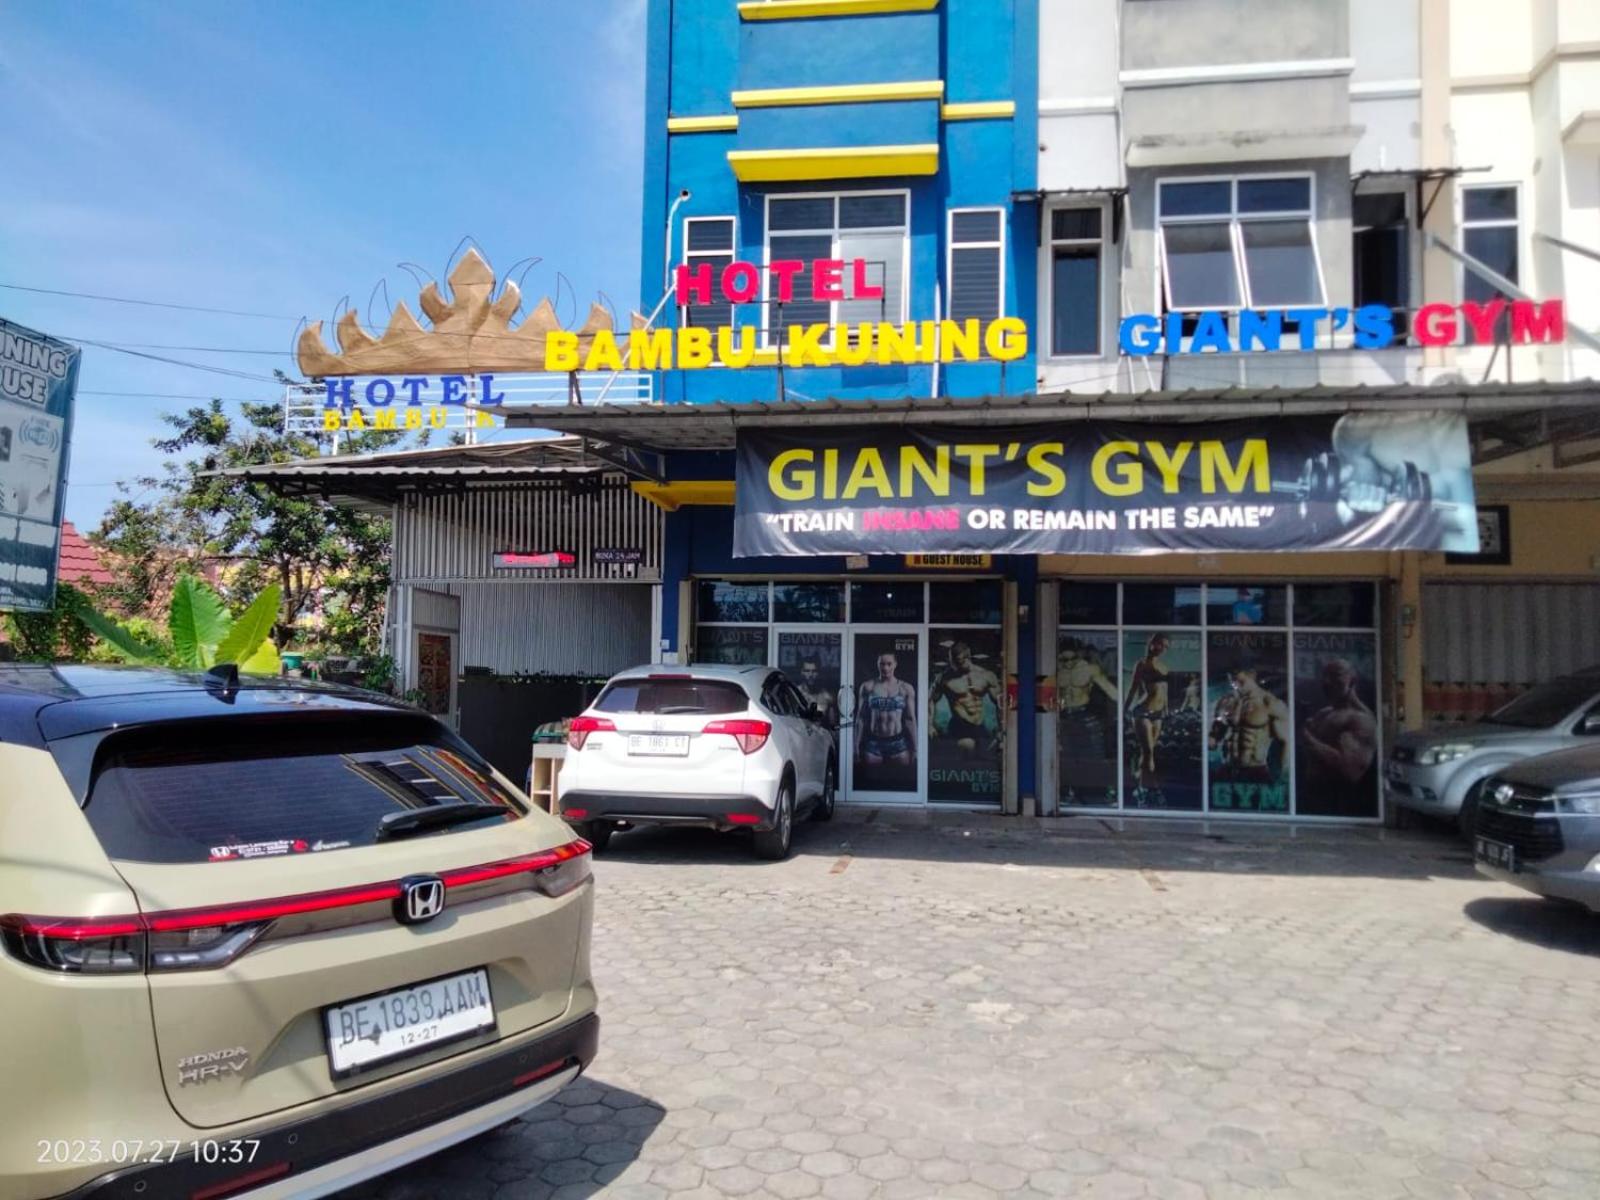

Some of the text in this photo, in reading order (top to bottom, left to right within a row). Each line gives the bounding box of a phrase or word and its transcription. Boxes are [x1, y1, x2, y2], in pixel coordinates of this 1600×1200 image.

[674, 258, 884, 305] HOTEL
[1119, 298, 1566, 357] GIANT'S GYM
[545, 317, 1028, 371] BAMBU KUNING
[324, 375, 505, 408] HOTEL
[322, 407, 448, 431] BAMBU
[768, 440, 1271, 501] GIANT'S GYM
[862, 508, 961, 531] INSANE
[967, 508, 1006, 529] OR
[1013, 509, 1117, 530] REMAIN
[1124, 508, 1176, 529] THE
[922, 554, 982, 565] GUEST HOUSE
[1213, 782, 1286, 808] GYM
[340, 1006, 370, 1046] BE
[441, 976, 483, 1017] AAM
[178, 1046, 248, 1068] HONDA
[179, 1058, 248, 1084] HR-V
